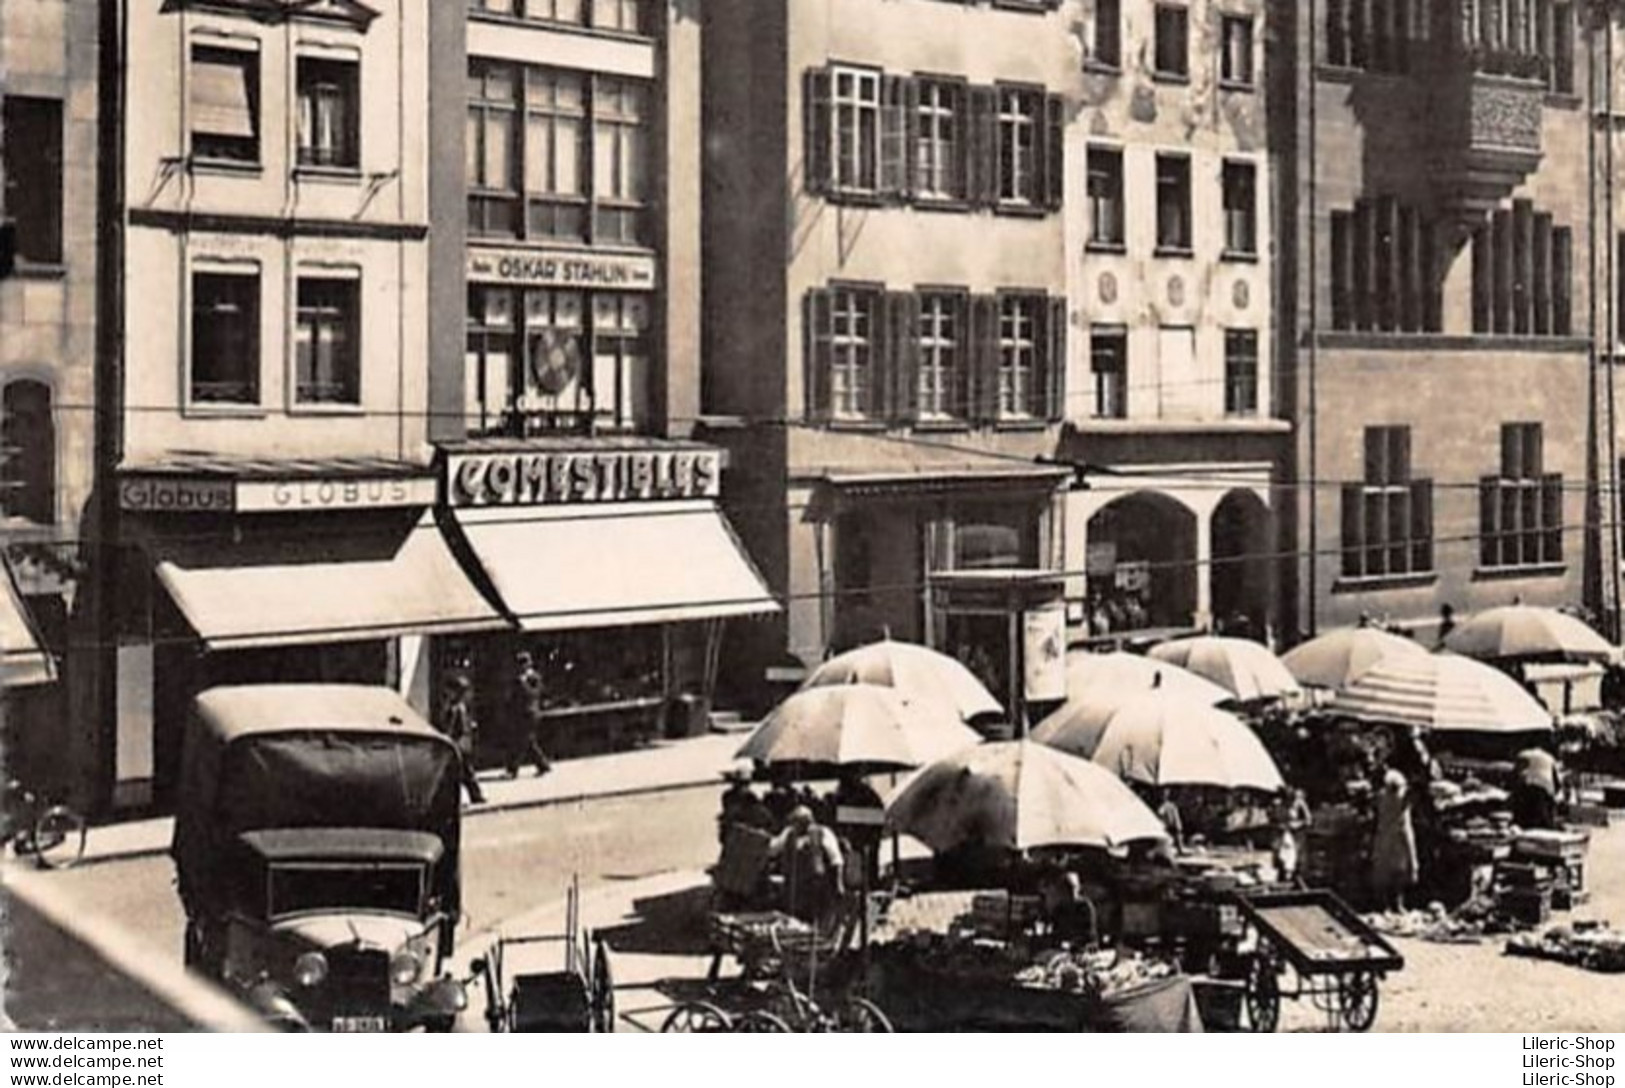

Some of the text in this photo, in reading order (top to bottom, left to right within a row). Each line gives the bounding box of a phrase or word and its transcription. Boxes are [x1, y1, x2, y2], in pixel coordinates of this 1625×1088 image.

[498, 257, 557, 279] OSKAR
[456, 455, 718, 503] COMESTIBLES
[120, 480, 232, 509] Globus
[273, 481, 407, 505] GLOBUS
